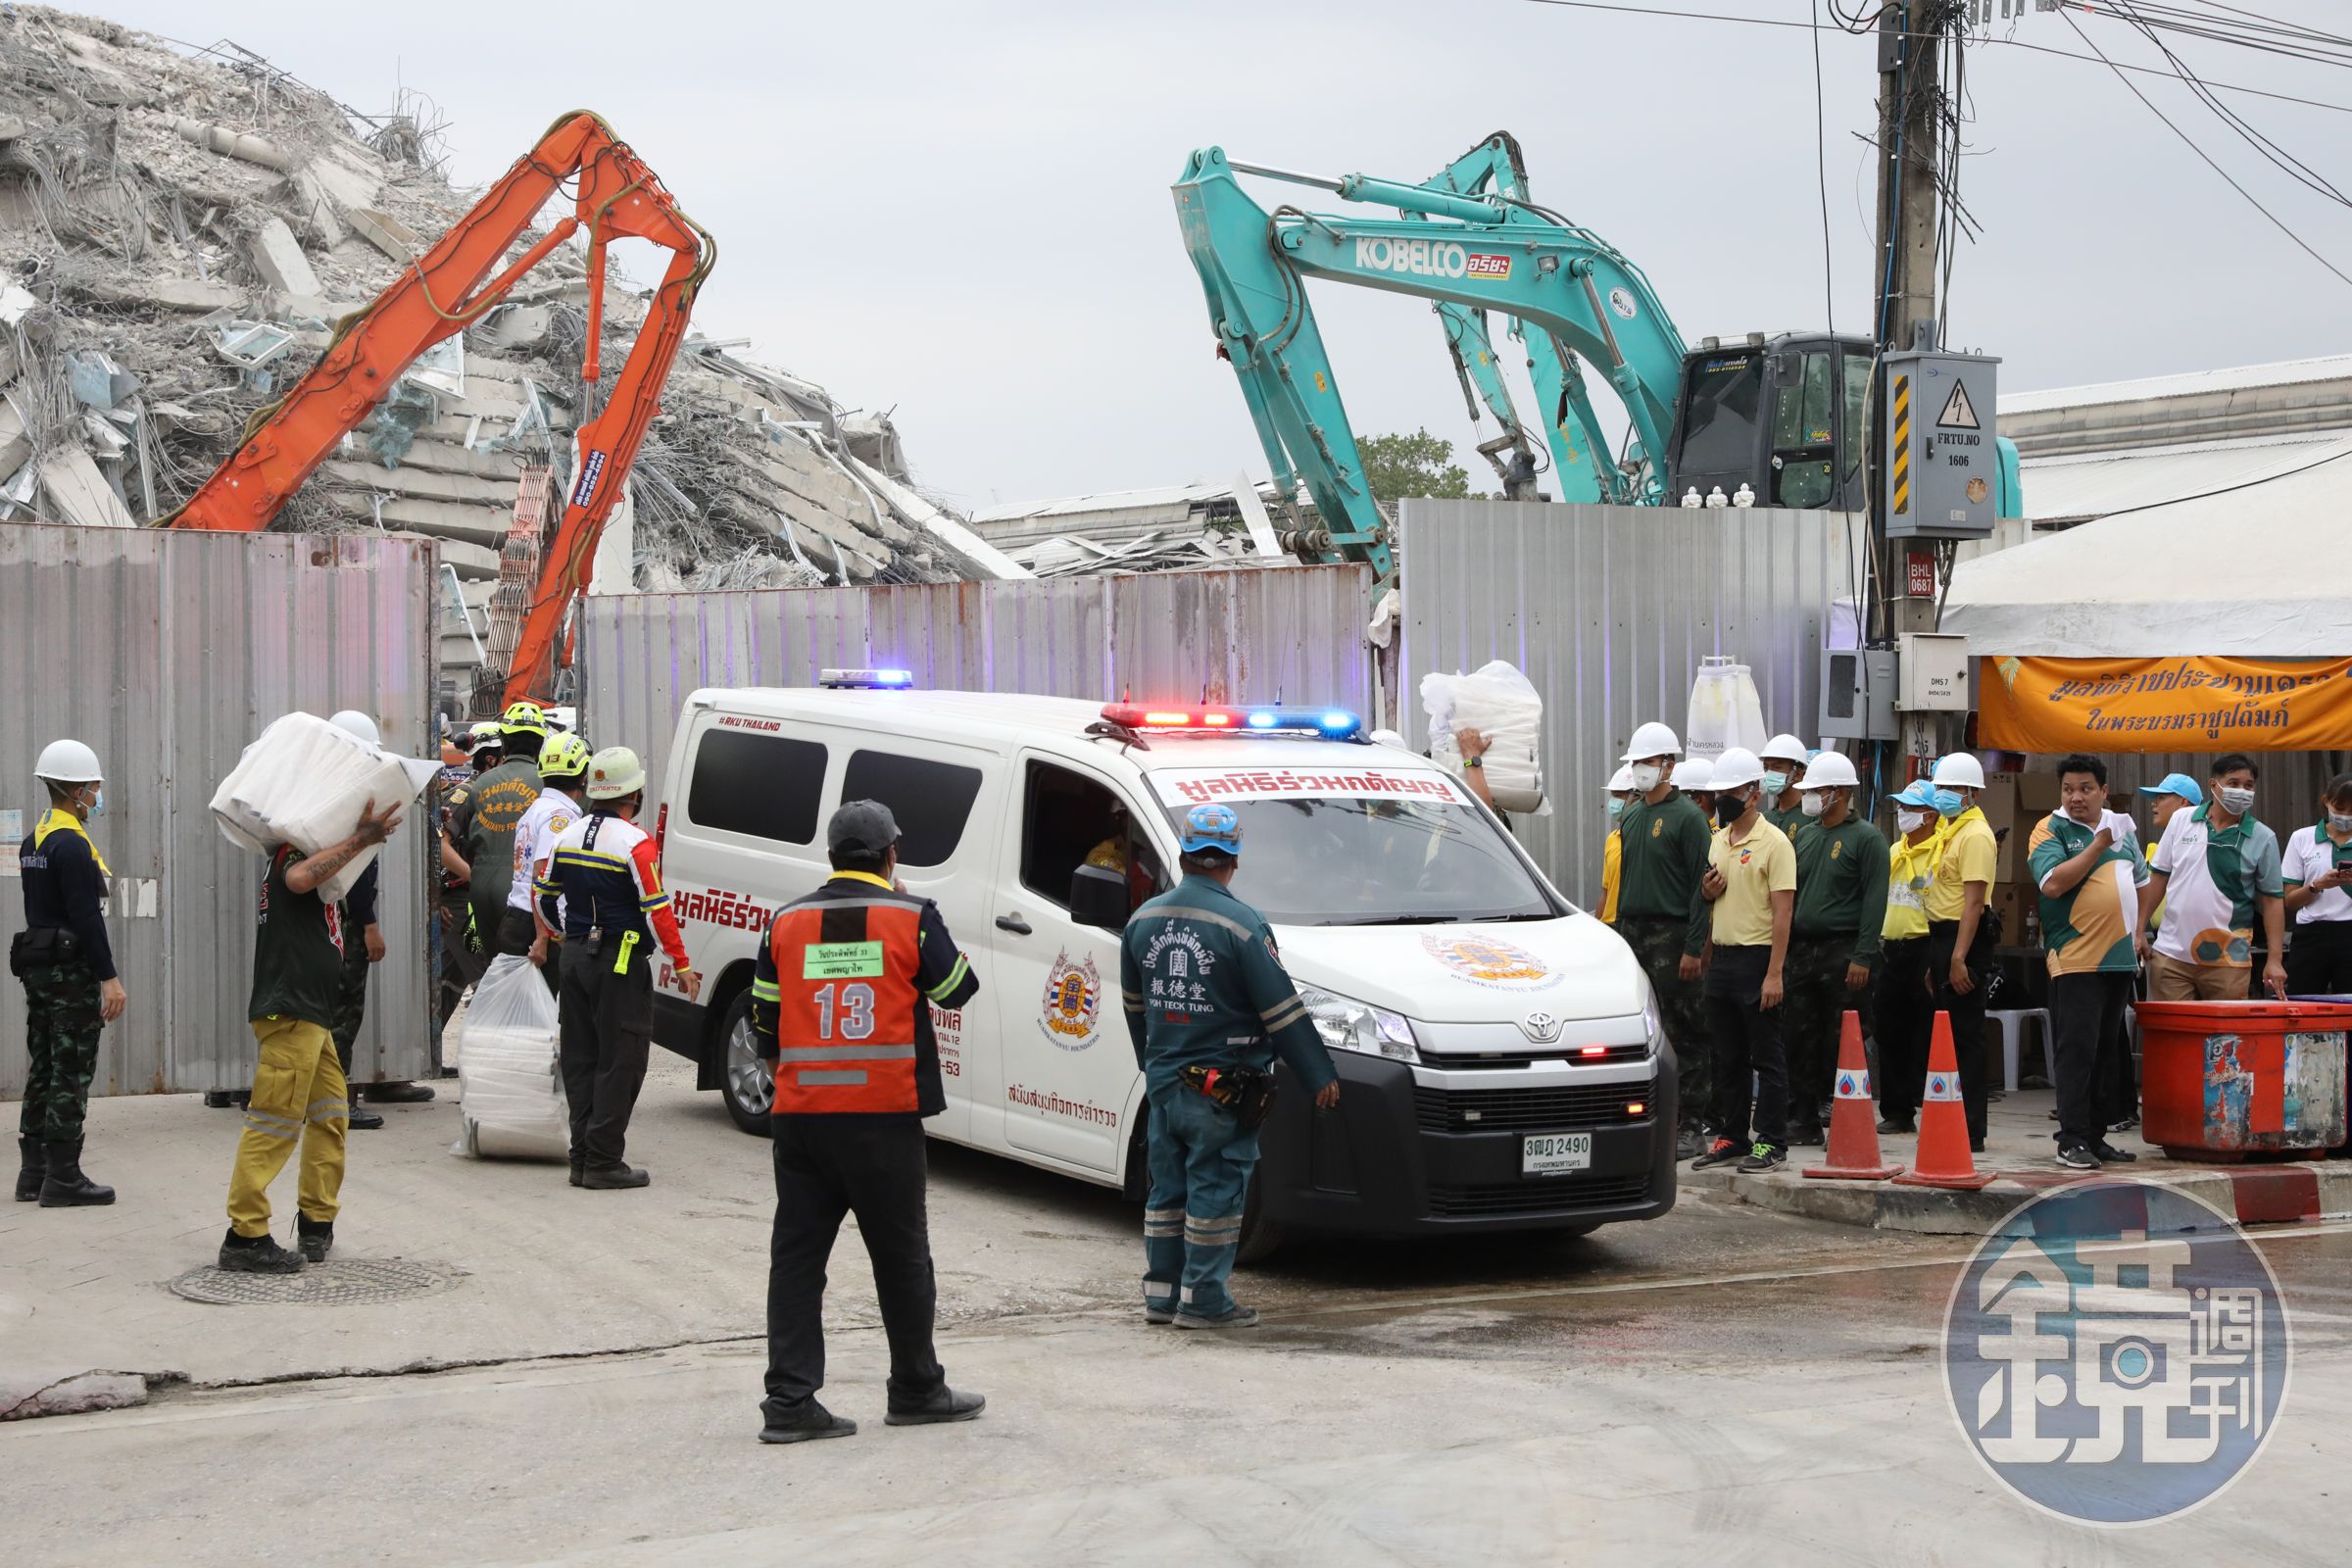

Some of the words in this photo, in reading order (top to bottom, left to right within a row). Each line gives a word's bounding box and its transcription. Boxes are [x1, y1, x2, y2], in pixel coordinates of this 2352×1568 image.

[1356, 237, 1466, 278] KOBELCO
[1948, 455, 1969, 466] 1606
[1911, 564, 1932, 577] BHL
[1911, 578, 1932, 592] 0687
[742, 718, 781, 731] THAILAND
[1176, 770, 1457, 803] มูลนิธิร่วมกตัญญู
[586, 825, 597, 845] FIRE
[1151, 977, 1206, 1001] 報德堂
[814, 983, 874, 1039] 13
[1164, 1001, 1185, 1010] TECK
[1189, 1003, 1214, 1012] TUNG
[941, 1060, 959, 1077] -53
[1008, 1083, 1116, 1128] สนับสนุนกิจการตำรวจ
[1556, 1137, 1589, 1154] 2490
